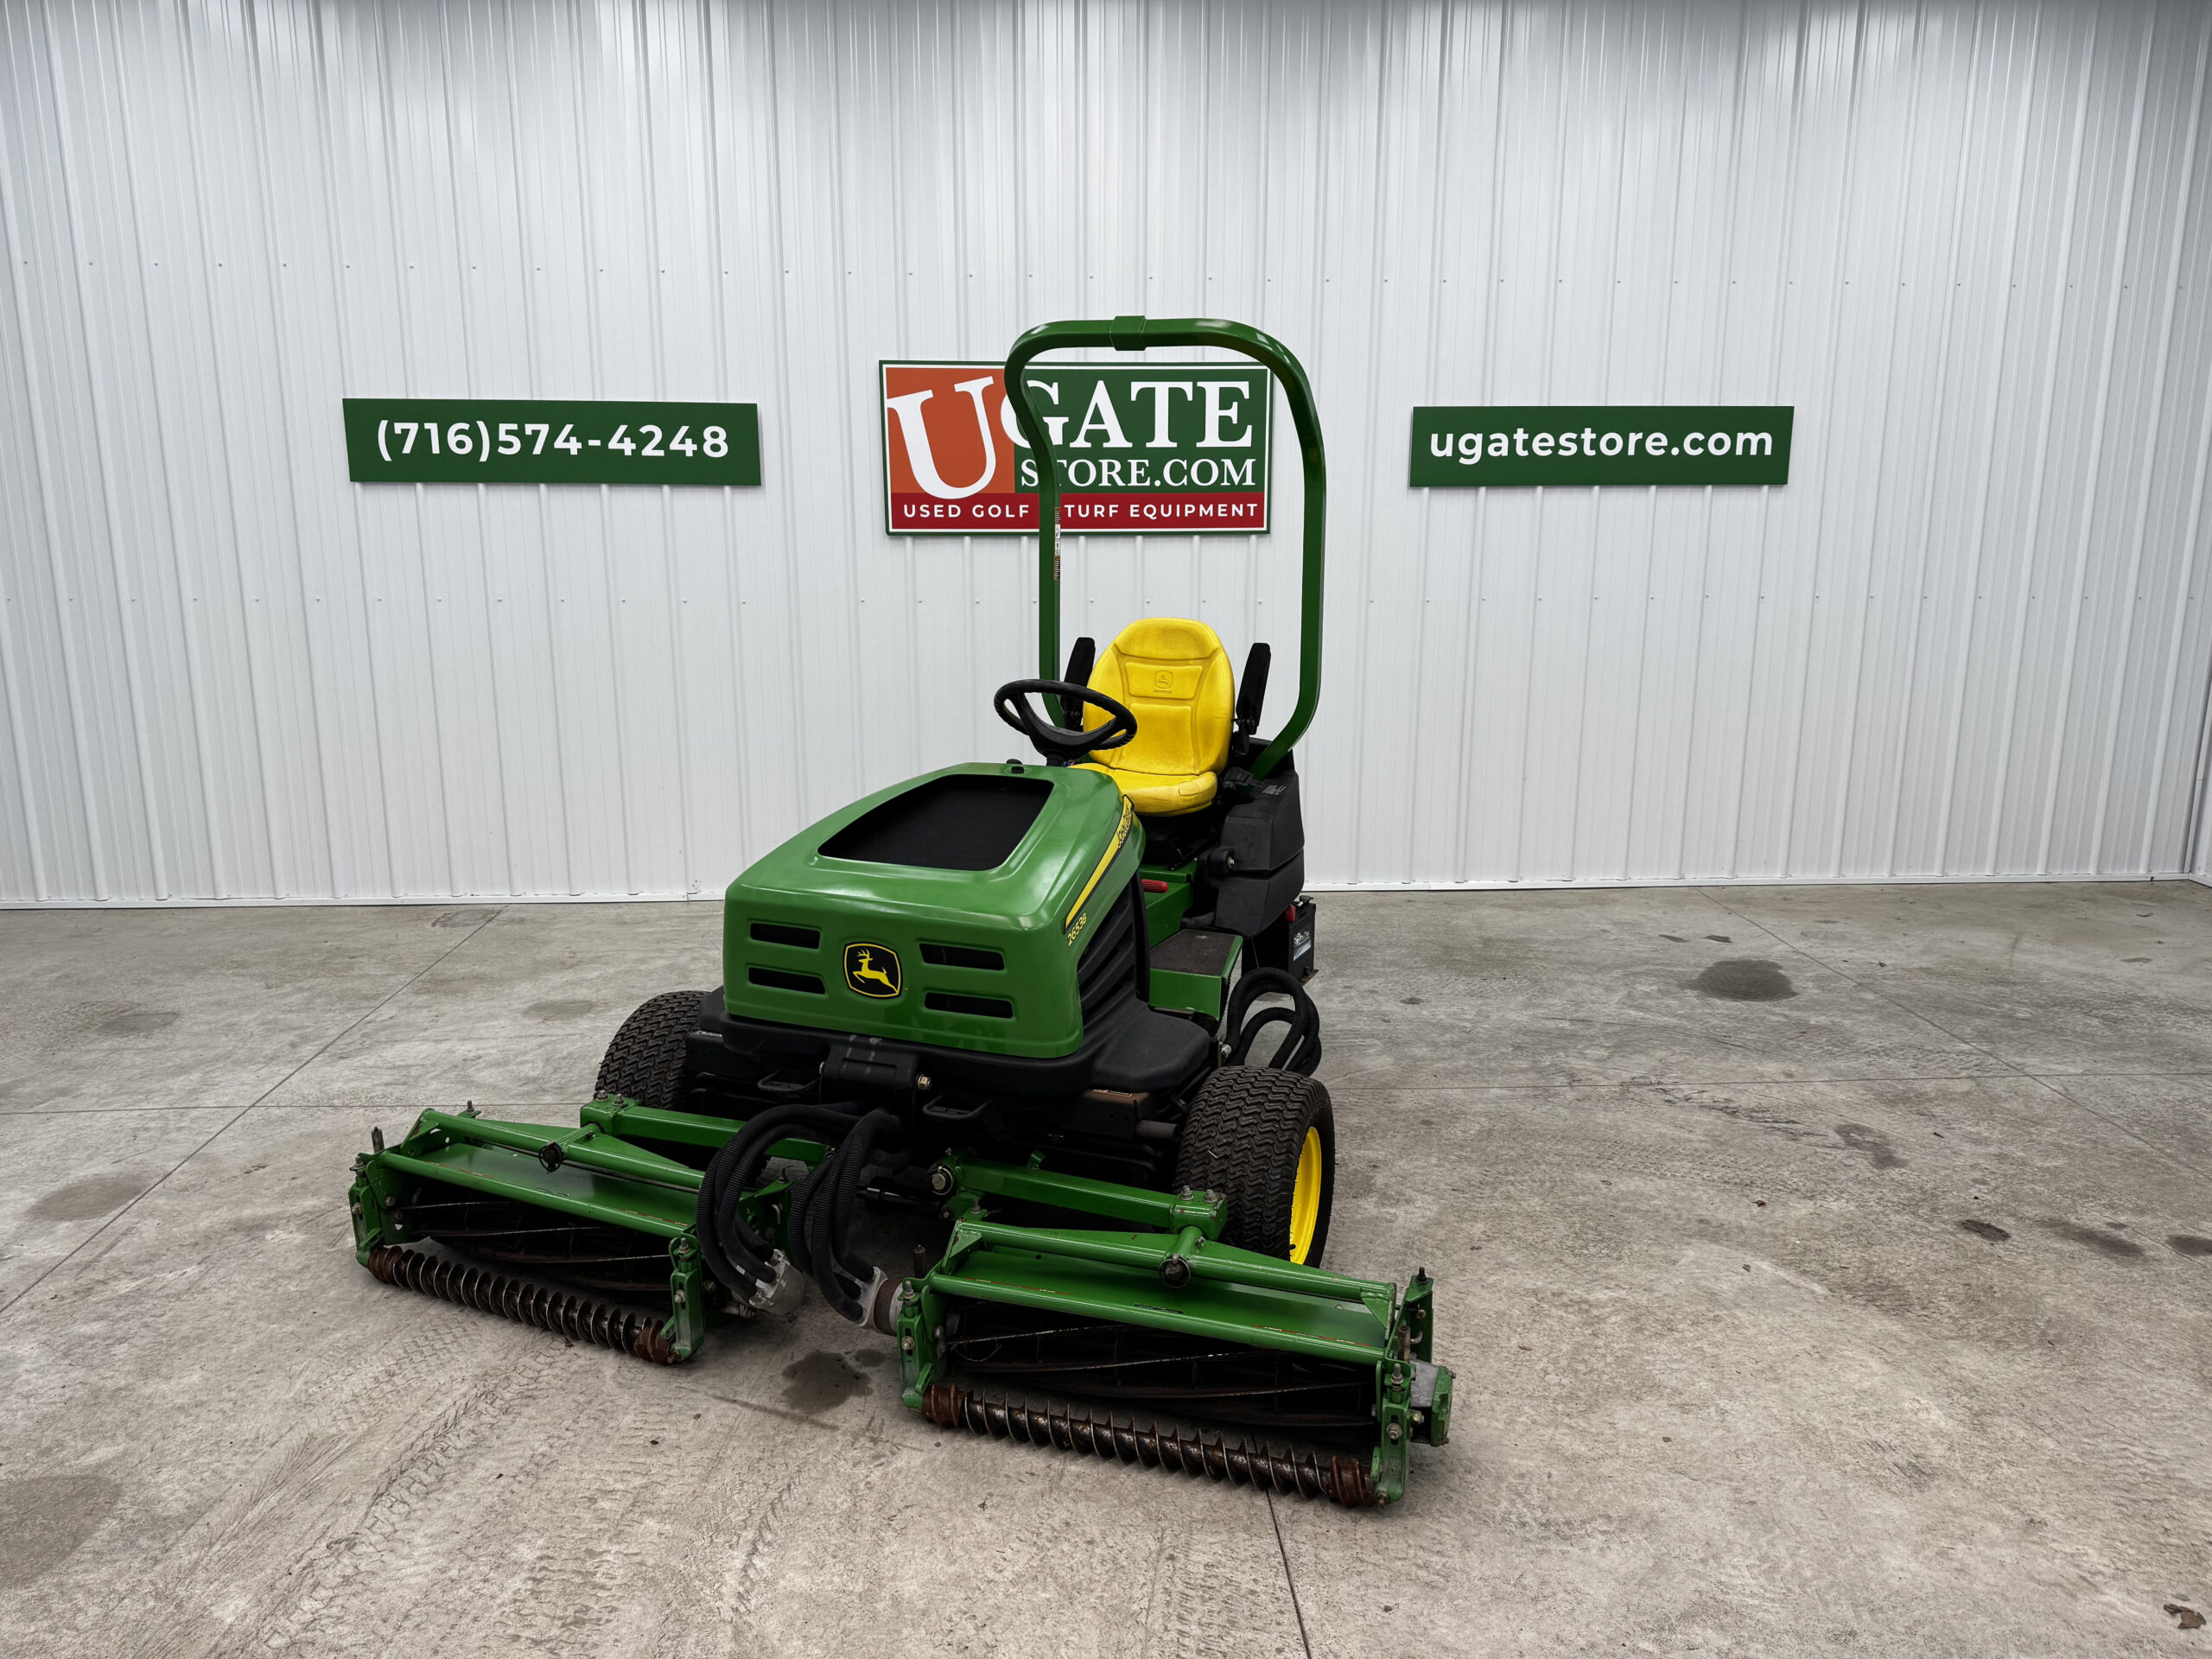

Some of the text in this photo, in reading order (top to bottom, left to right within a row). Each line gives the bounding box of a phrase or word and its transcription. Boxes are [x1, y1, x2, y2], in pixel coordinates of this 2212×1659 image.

[378, 419, 728, 462] (716)574-4248
[1430, 428, 1773, 466] ugatestore.com
[903, 503, 1258, 520] USED GOLF TURF EQUIPMENT
